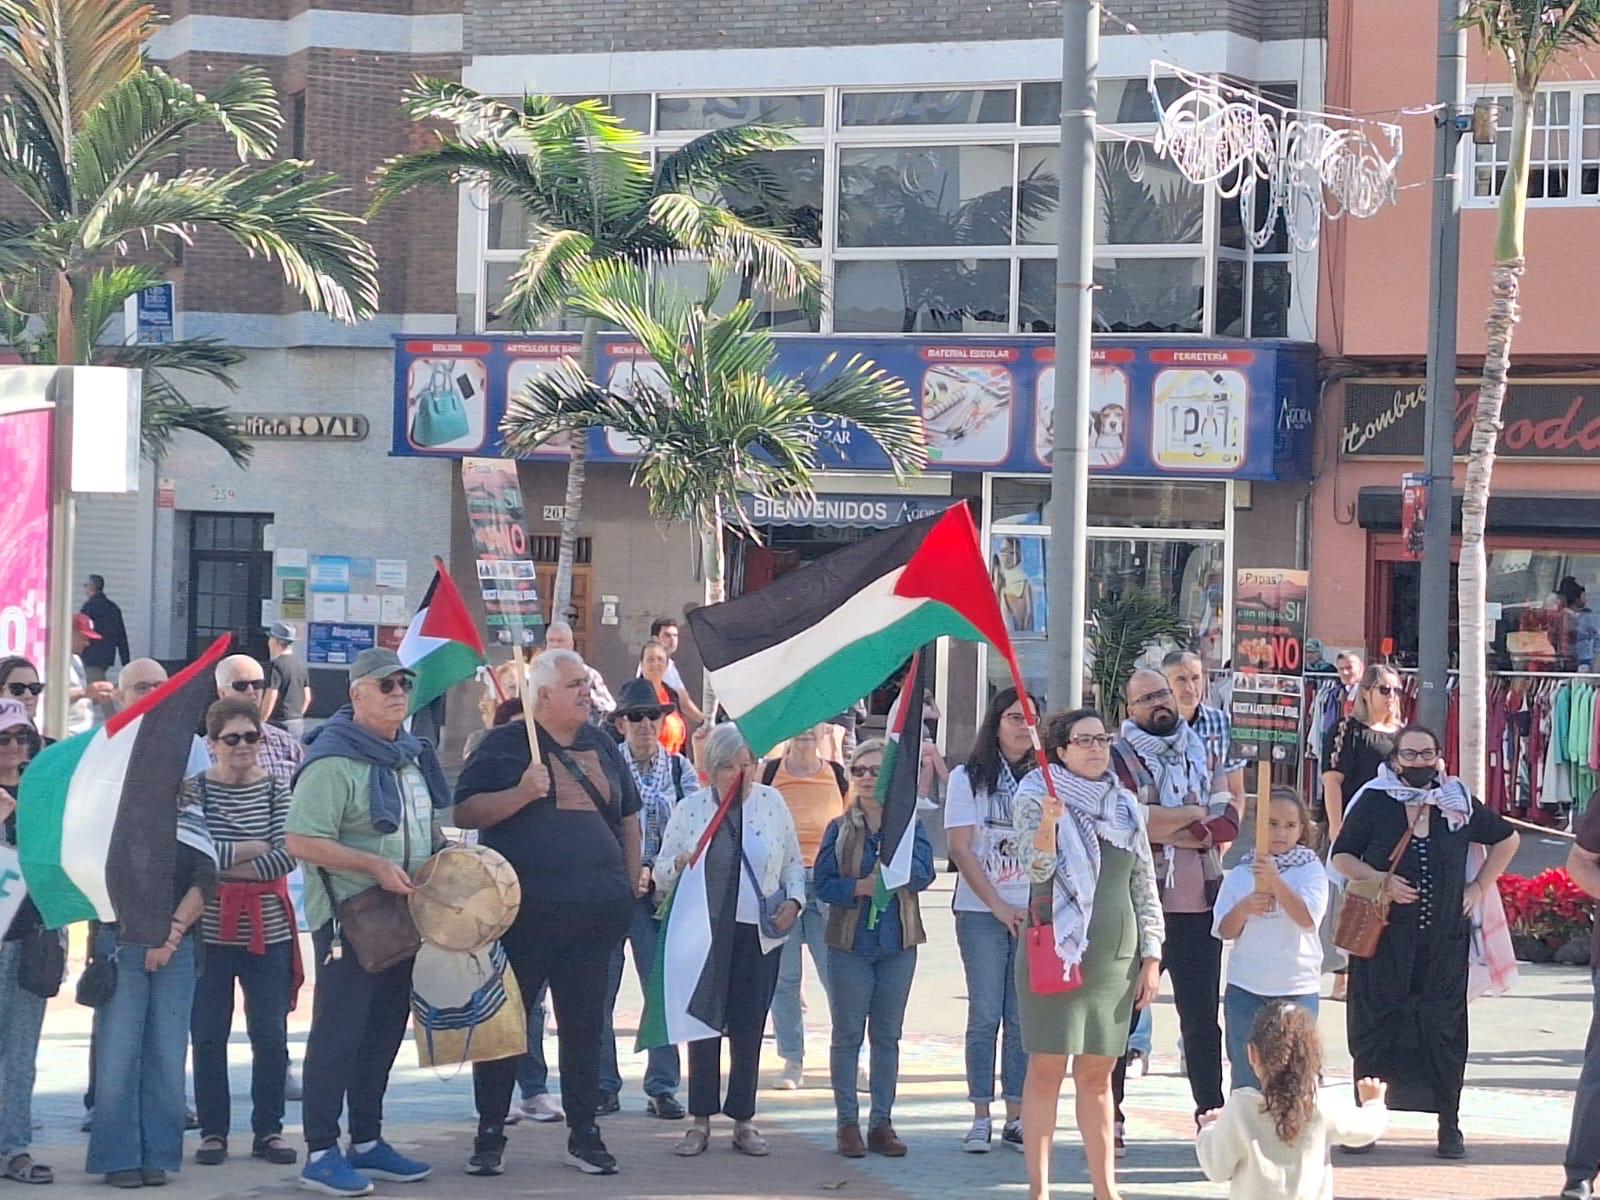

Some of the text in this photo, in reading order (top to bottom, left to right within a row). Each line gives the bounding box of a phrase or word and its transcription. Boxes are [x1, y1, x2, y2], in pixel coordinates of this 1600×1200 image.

[927, 348, 1009, 358] MATERIAL ESCOLAR
[290, 416, 358, 436] ROYAL
[753, 501, 888, 521] BIENVENIDOS
[1270, 636, 1300, 670] NO
